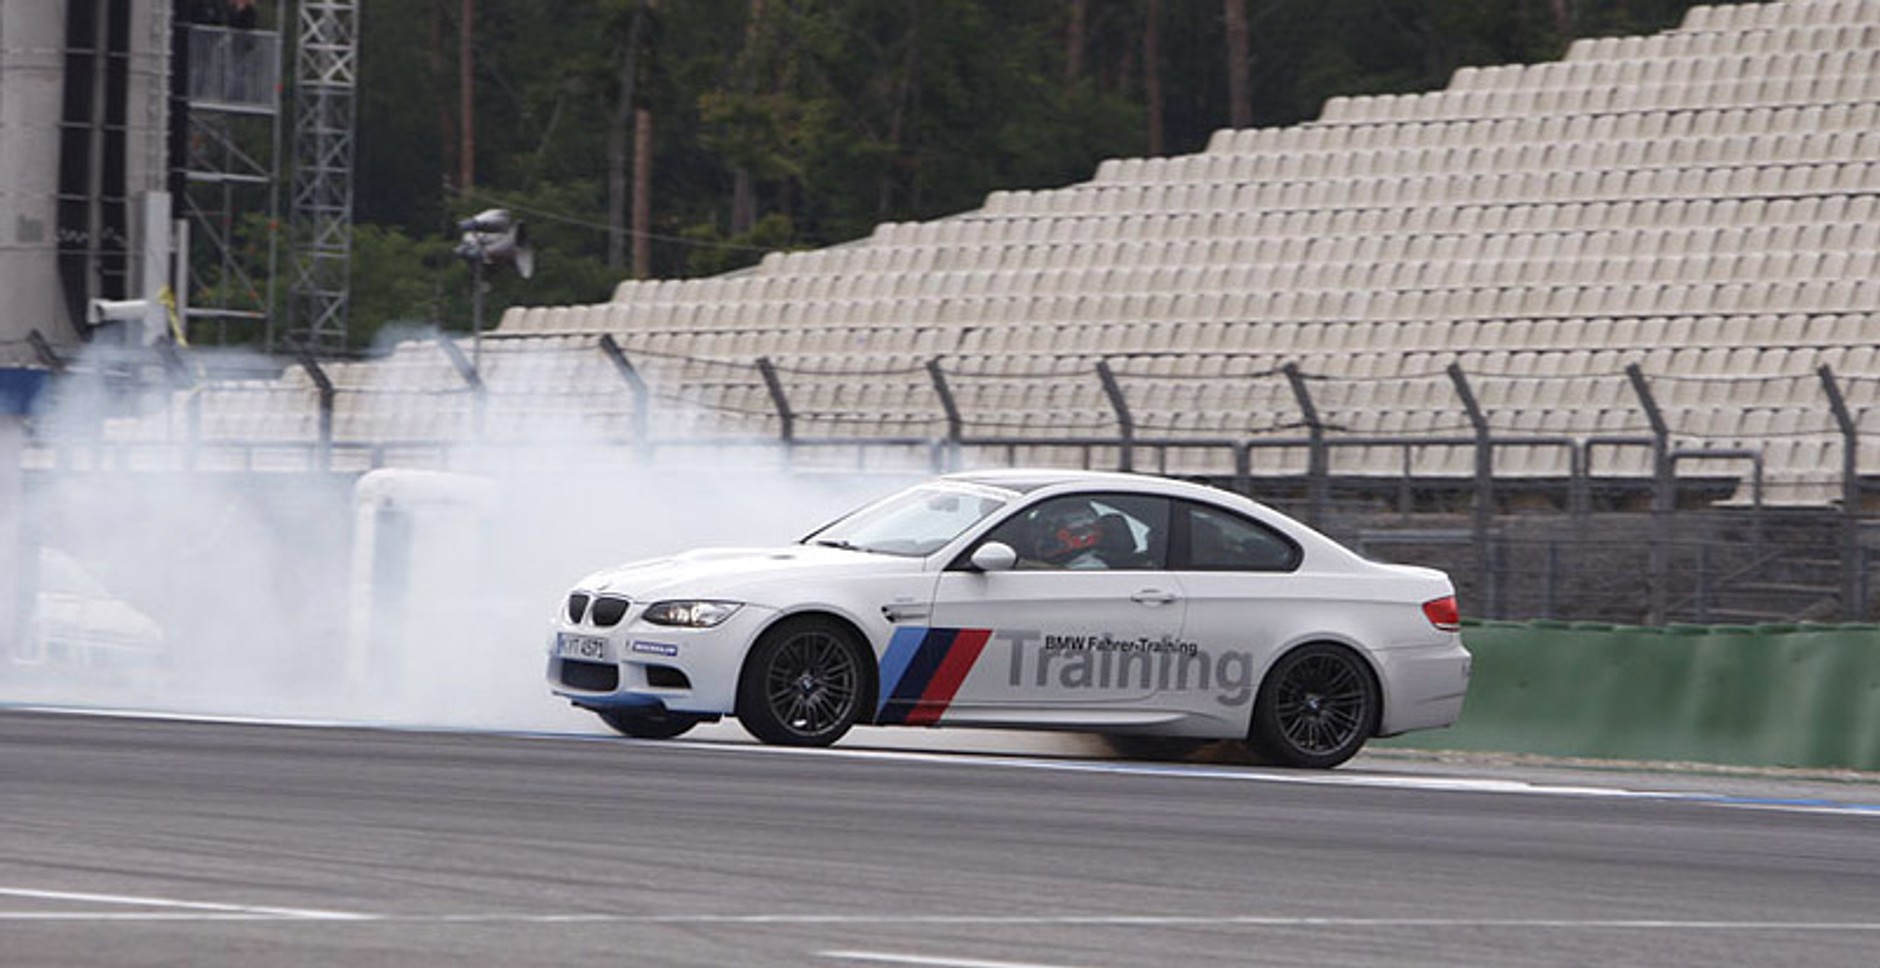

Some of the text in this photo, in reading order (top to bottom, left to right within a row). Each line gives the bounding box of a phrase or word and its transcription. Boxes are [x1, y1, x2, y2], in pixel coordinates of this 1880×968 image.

[997, 630, 1253, 706] Training
[1045, 635, 1198, 657] BMW Fahrer-Training
